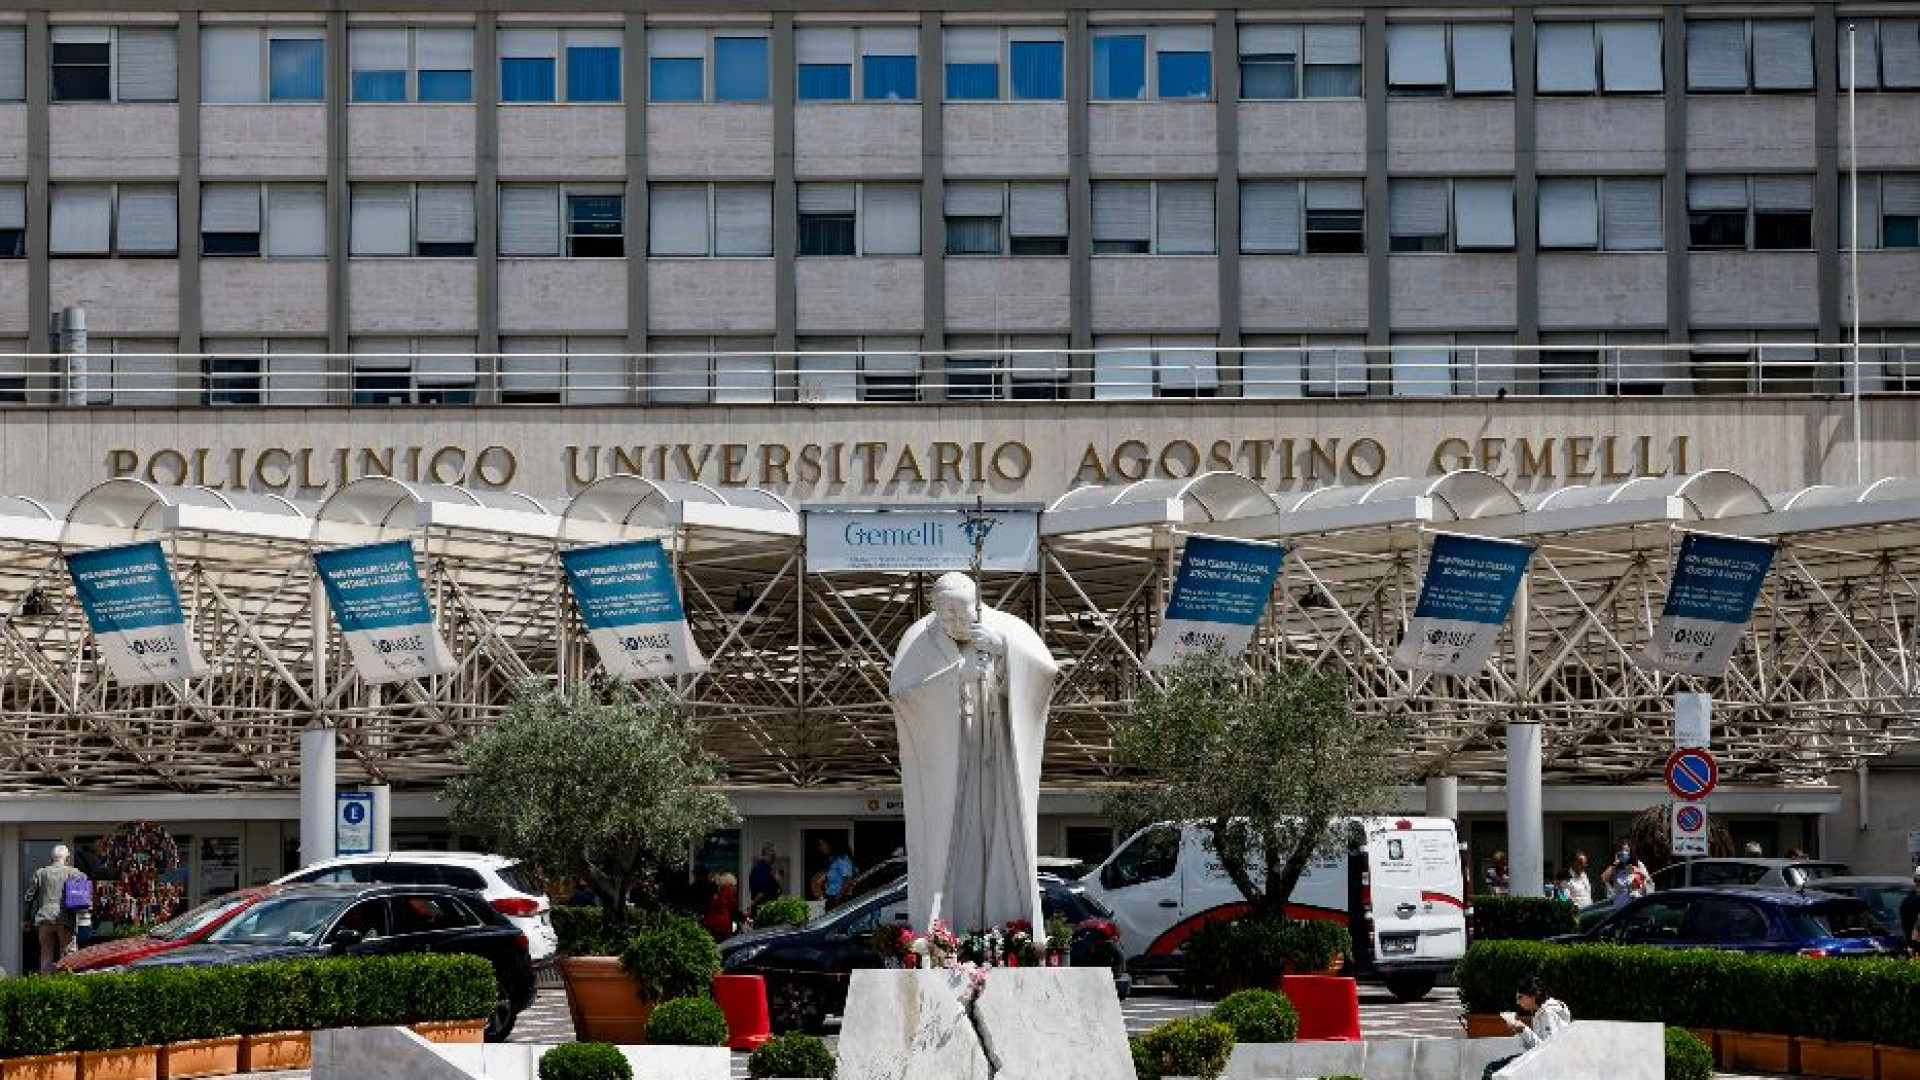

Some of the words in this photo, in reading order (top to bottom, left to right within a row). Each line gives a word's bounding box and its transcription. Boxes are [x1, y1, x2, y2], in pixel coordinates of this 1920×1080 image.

[111, 445, 517, 487] POLICLINICO
[565, 440, 1032, 484] UNIVERSITARIO
[1076, 438, 1386, 481] AGOSTINO
[1434, 436, 1688, 477] GEMELLI
[845, 521, 944, 546] Gemelli
